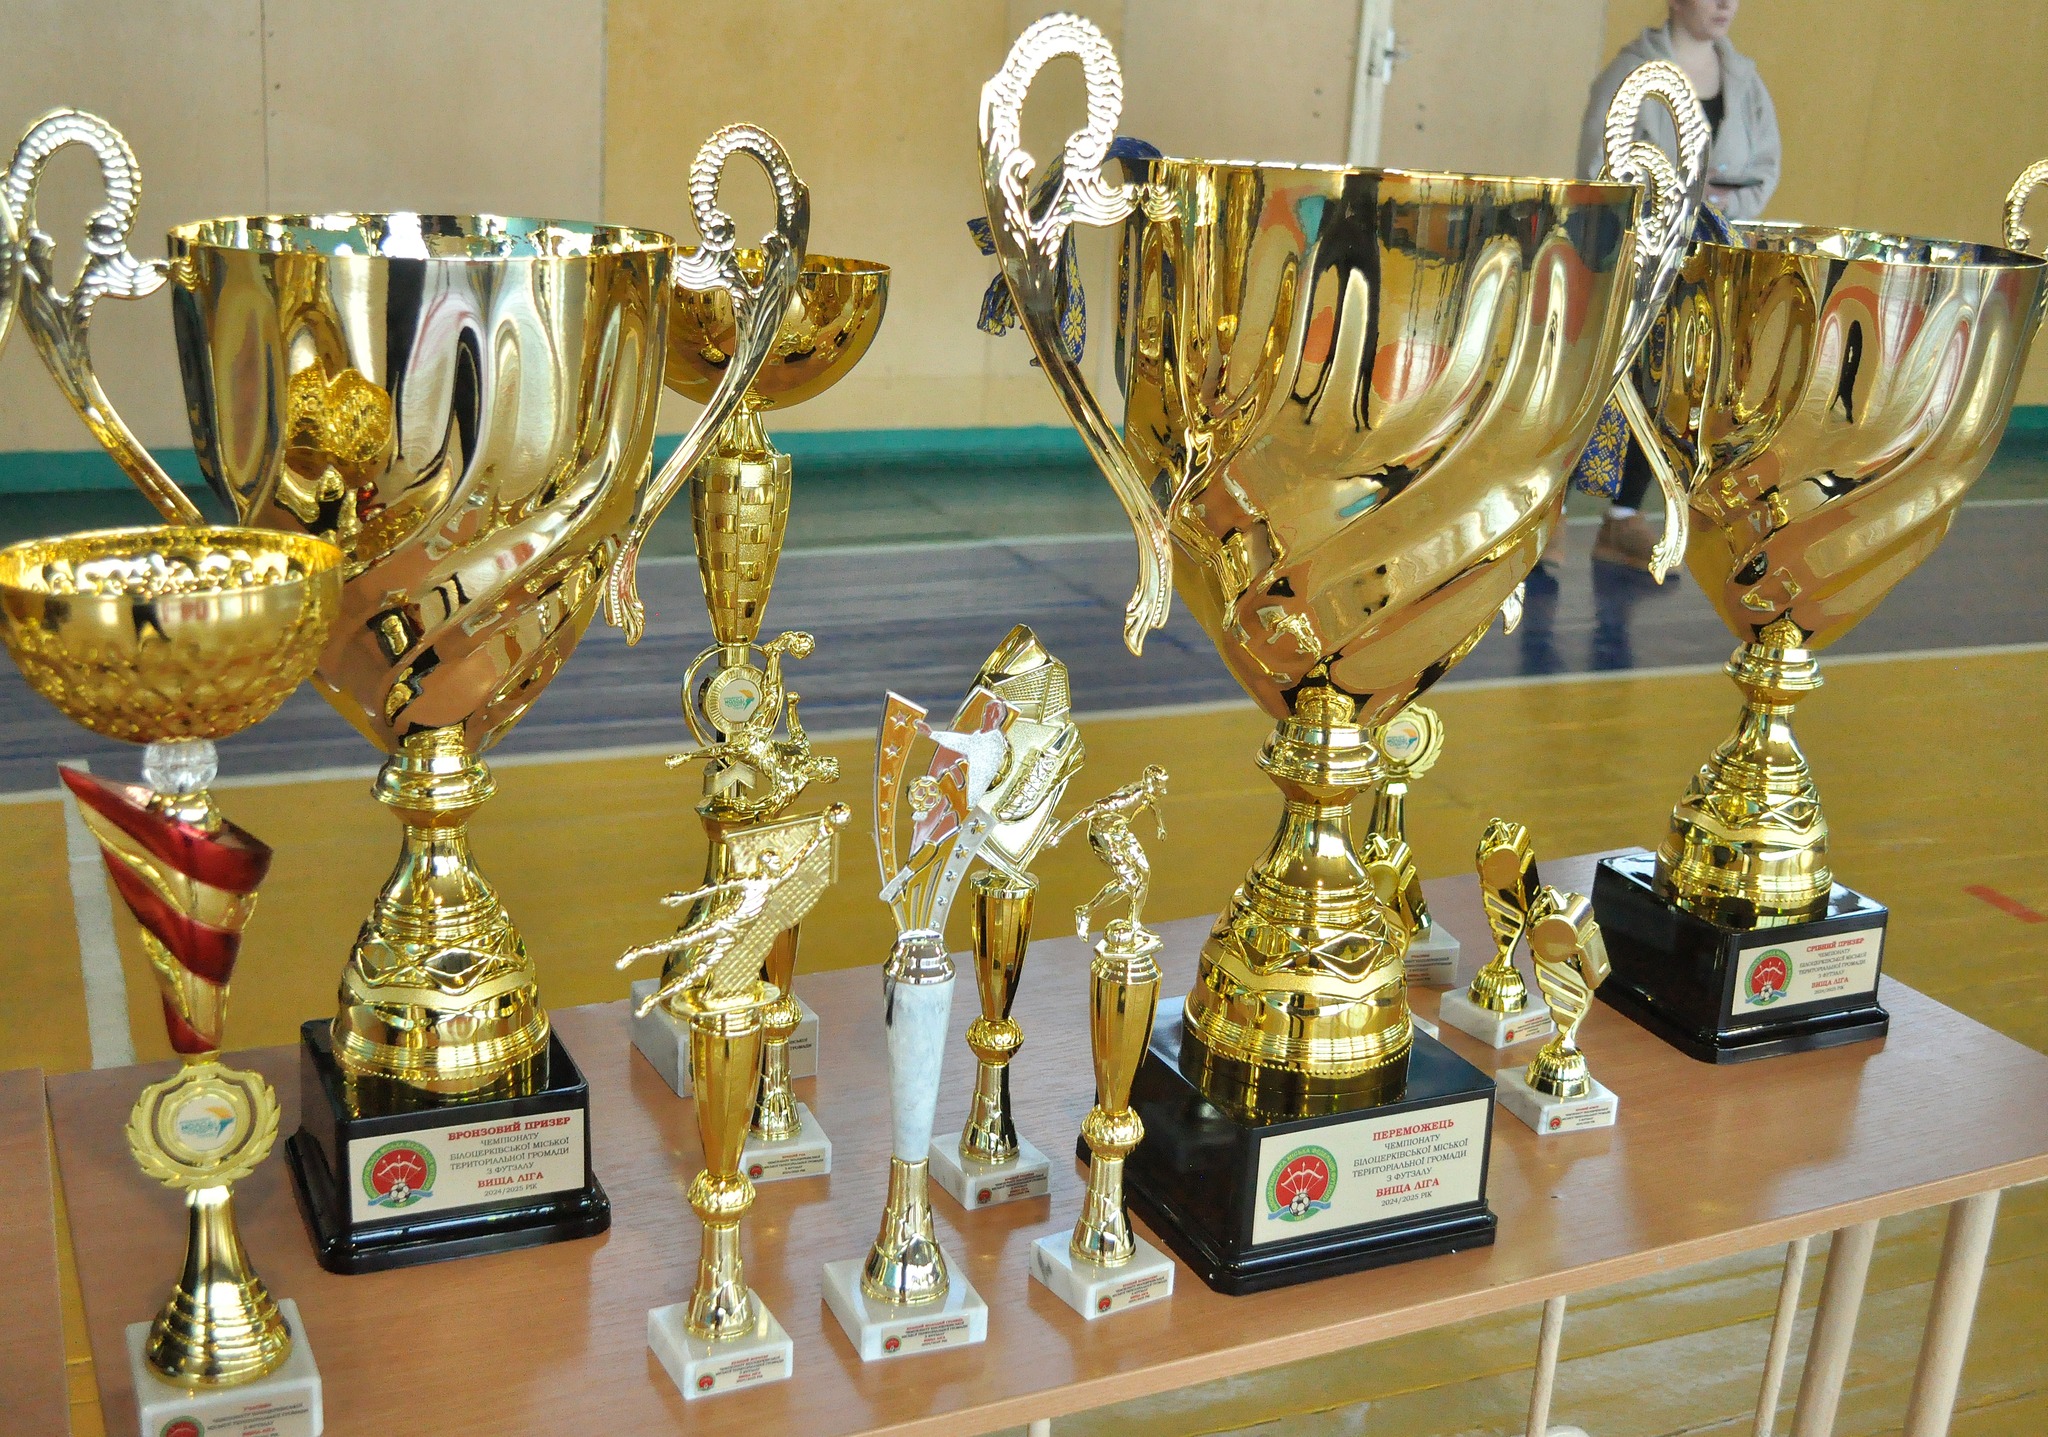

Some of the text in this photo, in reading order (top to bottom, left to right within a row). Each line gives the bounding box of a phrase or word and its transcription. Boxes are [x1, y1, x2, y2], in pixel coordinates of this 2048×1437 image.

[448, 1117, 570, 1140] БРОНЗОВИЙ ПРИЗЕР
[1372, 1119, 1454, 1141] ПЕРЕМОЖЕЦЬ
[481, 1132, 539, 1146] ЧЕМПІОНАТУ
[533, 1137, 569, 1149] МІСЬКОЇ
[1384, 1134, 1440, 1150] ЧЕМПІОНАТУ
[450, 1148, 569, 1170] ТЕРИТОРІАЛЬНОЇ ГРОМАДИ
[1354, 1146, 1430, 1167] БІЛОЦЕРКІВСЬКОЇ
[1433, 1138, 1468, 1152] МІСЬКОЇ
[494, 1162, 534, 1173] ФУТЗАЛУ
[1352, 1158, 1424, 1178] ТЕРИТОРІАЛЬНОЇ
[1427, 1150, 1467, 1164] ГРОМАДИ
[478, 1172, 544, 1188] ВИЩА ЛІГА
[1394, 1168, 1432, 1180] ФУТЗАЛУ
[484, 1186, 524, 1196] 2024/2025
[1376, 1178, 1440, 1197] ВИЩА ЛІГА
[1382, 1190, 1432, 1206] 2024/2025 РІК
